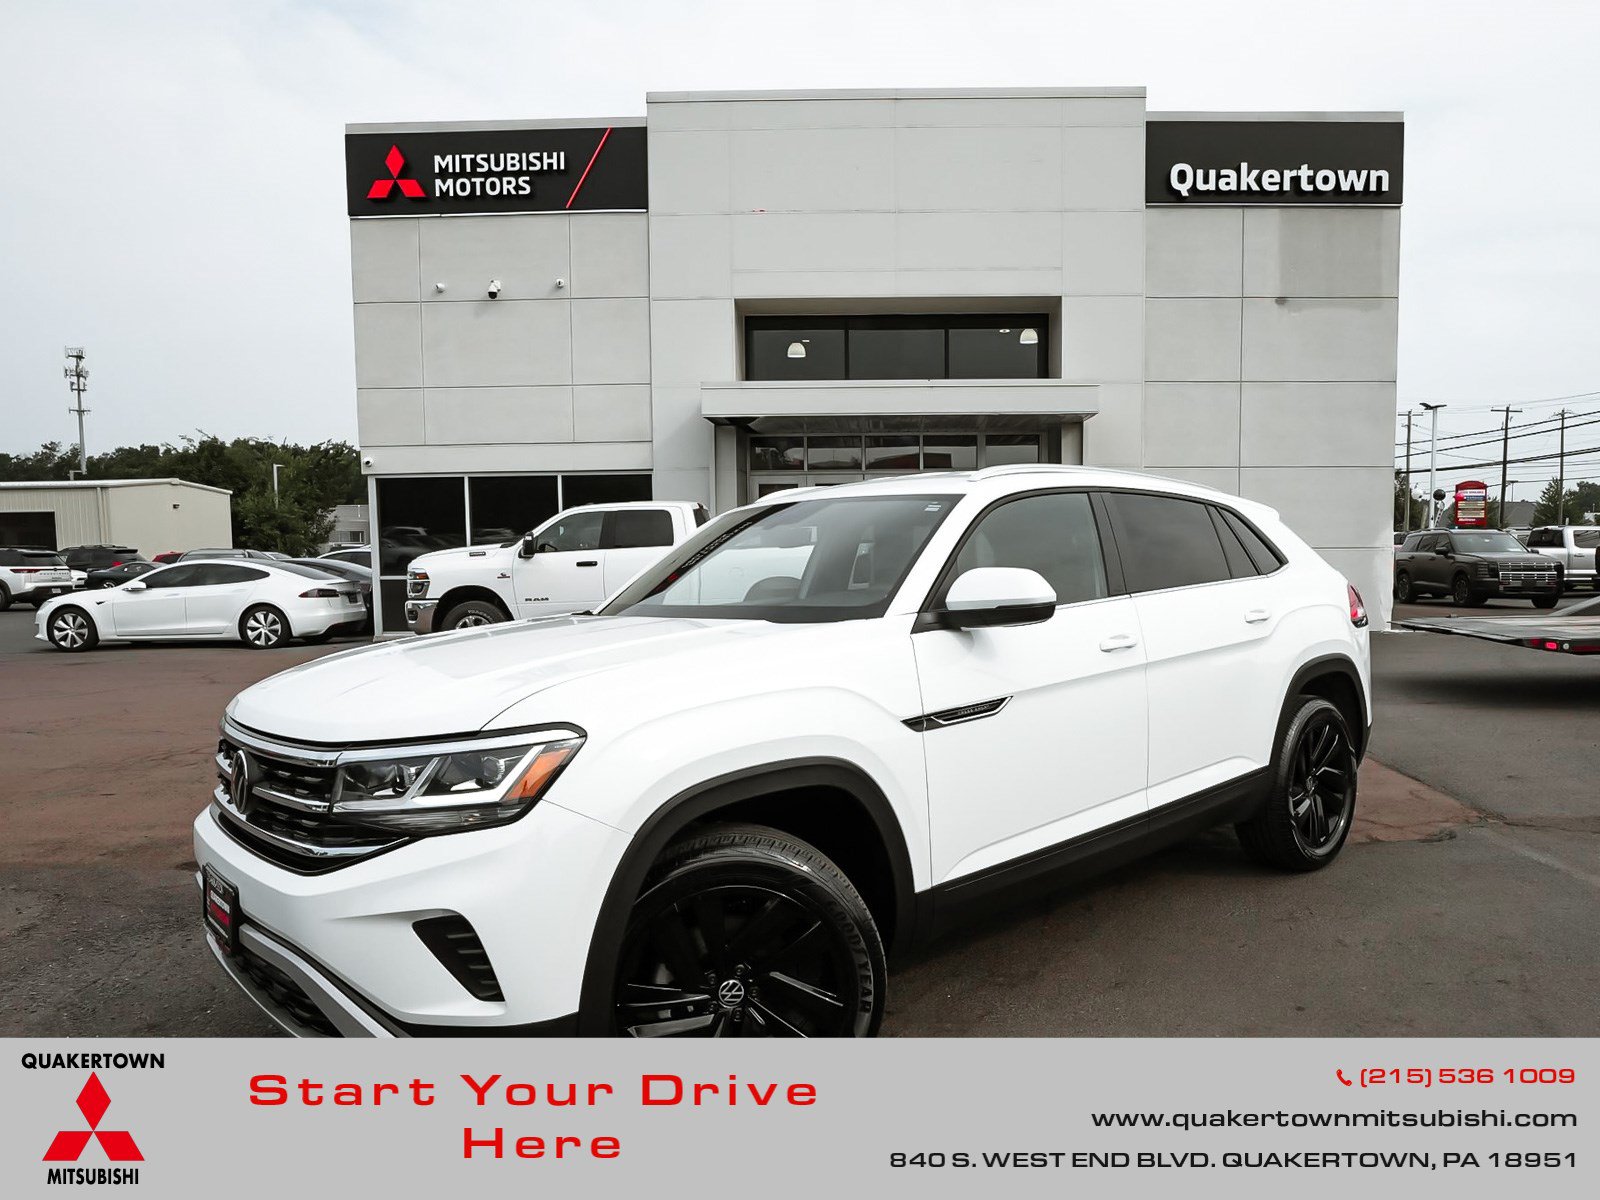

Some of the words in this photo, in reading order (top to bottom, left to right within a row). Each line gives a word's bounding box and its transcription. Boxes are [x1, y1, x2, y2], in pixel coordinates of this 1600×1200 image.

[434, 151, 565, 174] MITSUBISHI
[435, 176, 531, 197] MOTORS
[1170, 162, 1390, 197] Quakertown
